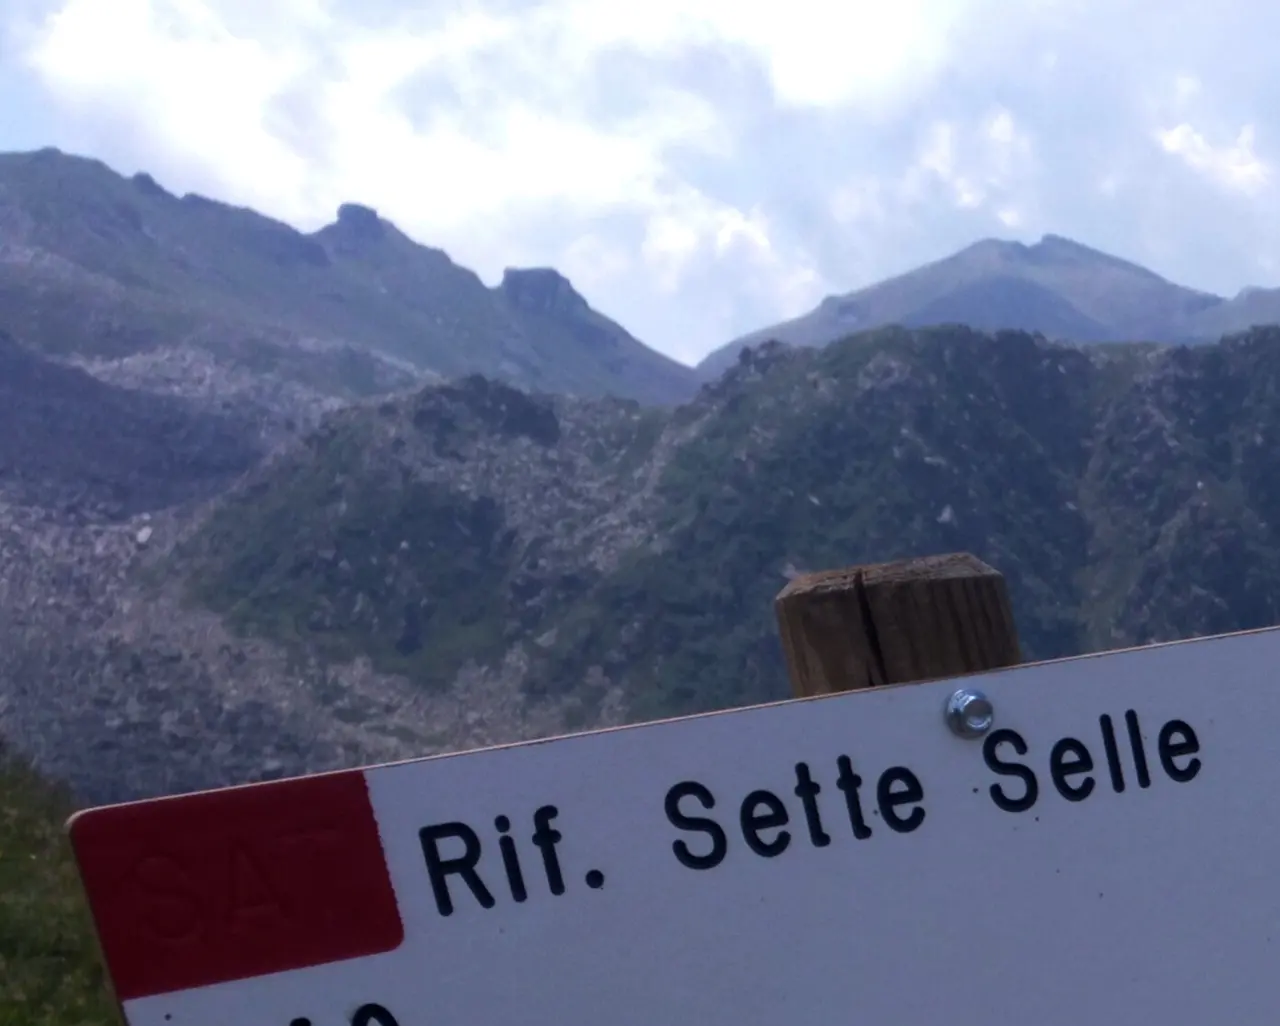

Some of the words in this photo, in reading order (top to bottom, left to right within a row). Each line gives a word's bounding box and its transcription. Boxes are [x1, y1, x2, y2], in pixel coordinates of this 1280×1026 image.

[418, 804, 605, 917] Rif.
[663, 754, 926, 870] Sette
[982, 708, 1202, 813] Selle
